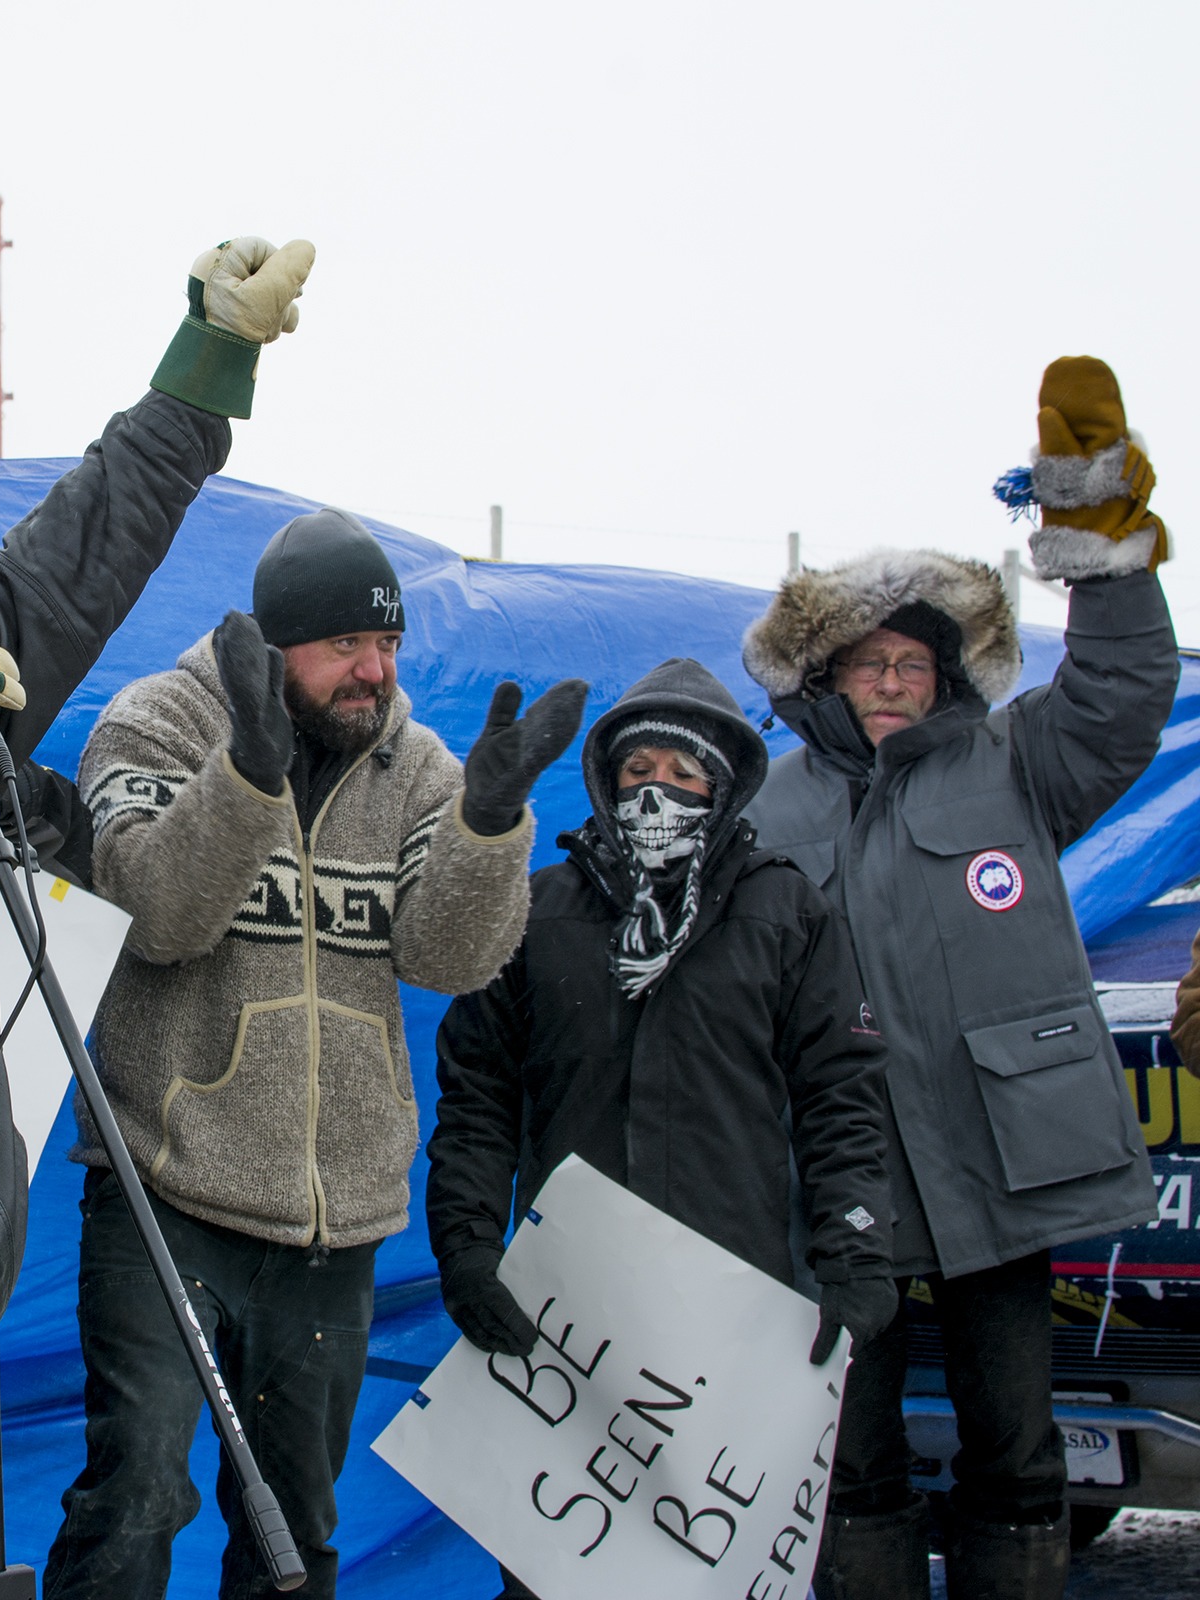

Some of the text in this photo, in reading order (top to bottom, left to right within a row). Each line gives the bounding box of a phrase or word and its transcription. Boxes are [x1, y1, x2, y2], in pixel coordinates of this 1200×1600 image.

[487, 1296, 612, 1429] BE
[531, 1367, 707, 1558] SEEN,
[653, 1445, 766, 1568] BE
